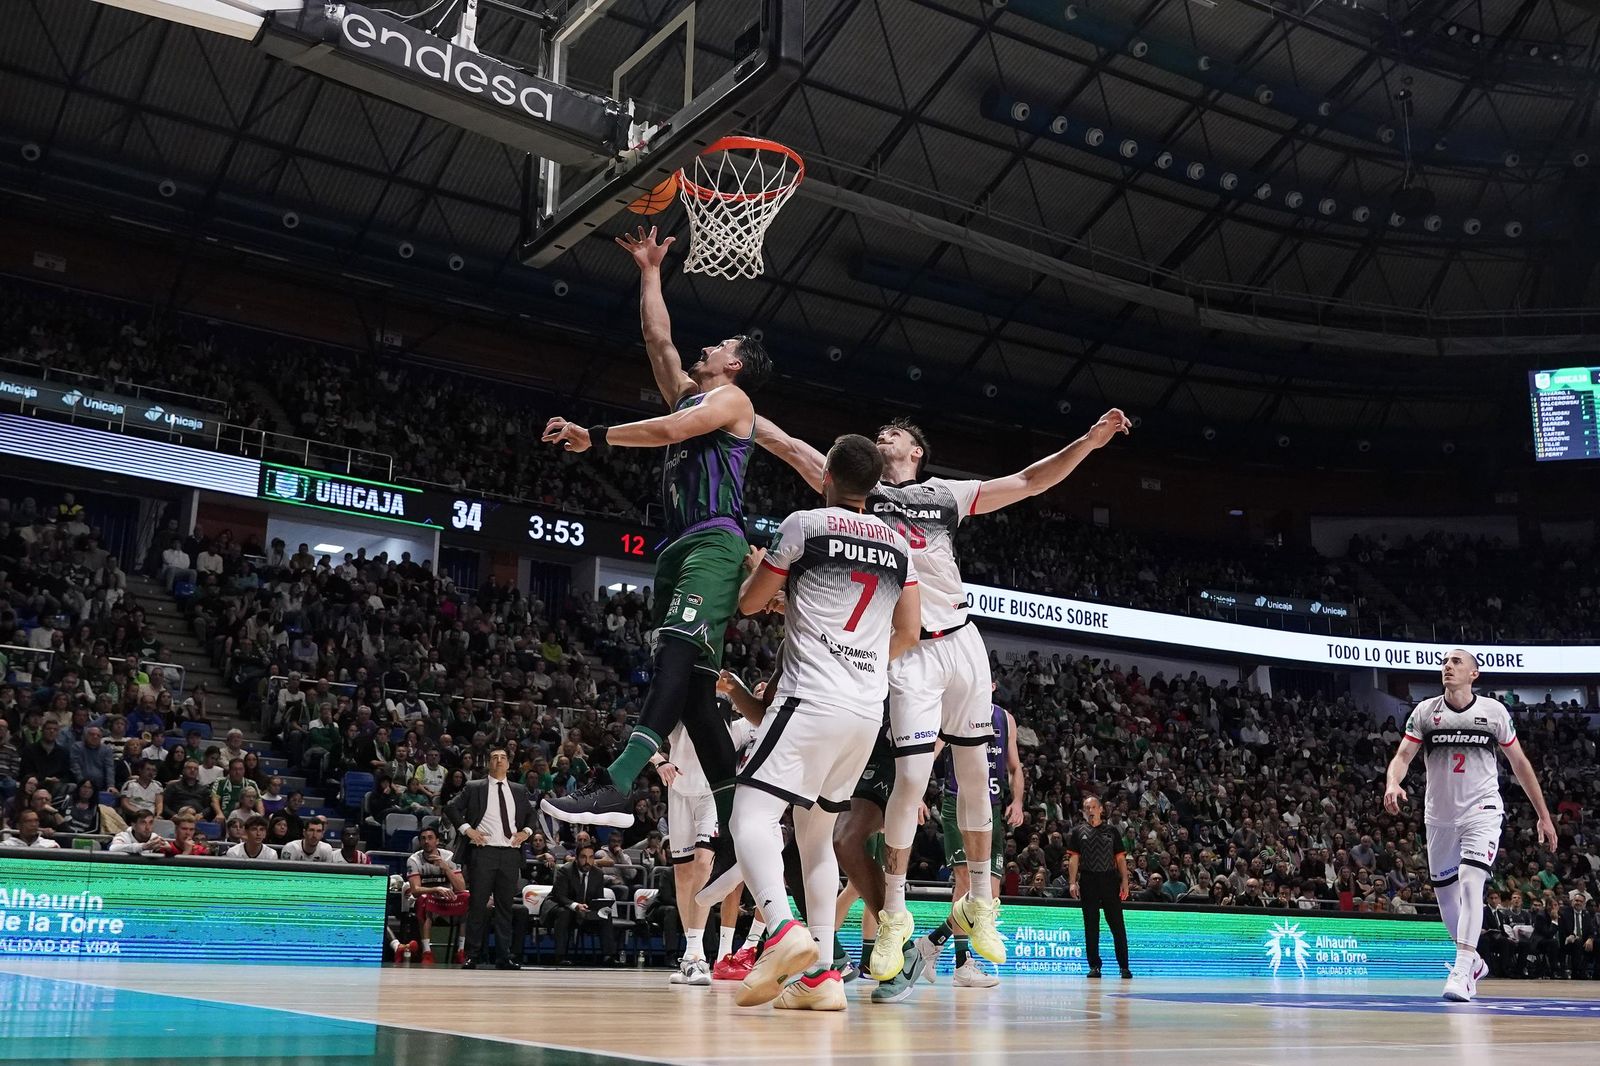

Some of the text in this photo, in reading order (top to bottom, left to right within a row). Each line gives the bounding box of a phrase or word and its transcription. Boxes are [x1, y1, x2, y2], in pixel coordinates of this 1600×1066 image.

[341, 13, 553, 121] endesa
[82, 398, 124, 415] Unicaja
[165, 413, 203, 430] Unicaja
[316, 480, 404, 516] UNICAJA
[452, 500, 482, 532] 34
[528, 515, 585, 547] 3:53
[827, 516, 896, 544] BAMFORTH
[621, 533, 646, 556] 12
[829, 539, 898, 570] PULEVA
[843, 570, 879, 632] 7
[980, 594, 1006, 613] QUE
[1010, 599, 1063, 622] BUSCAS
[1067, 608, 1109, 629] SOBRE
[1267, 601, 1293, 611] Unicaja
[1322, 606, 1347, 617] Unicaja
[1327, 644, 1525, 668] TODO LO QUE BUS SOBRE
[1452, 753, 1466, 773] 2
[0, 888, 103, 910] Alhaurín
[28, 911, 50, 932] la
[57, 912, 124, 935] Torre
[1015, 926, 1071, 942] Alhaurín
[60, 940, 81, 953] DE
[85, 941, 121, 954] VIDA
[1015, 942, 1082, 958] de la Torre
[1316, 935, 1358, 948] Alhaurín
[1015, 962, 1082, 972] CALIDAD DE VIDA
[1316, 949, 1367, 963] de la Torre
